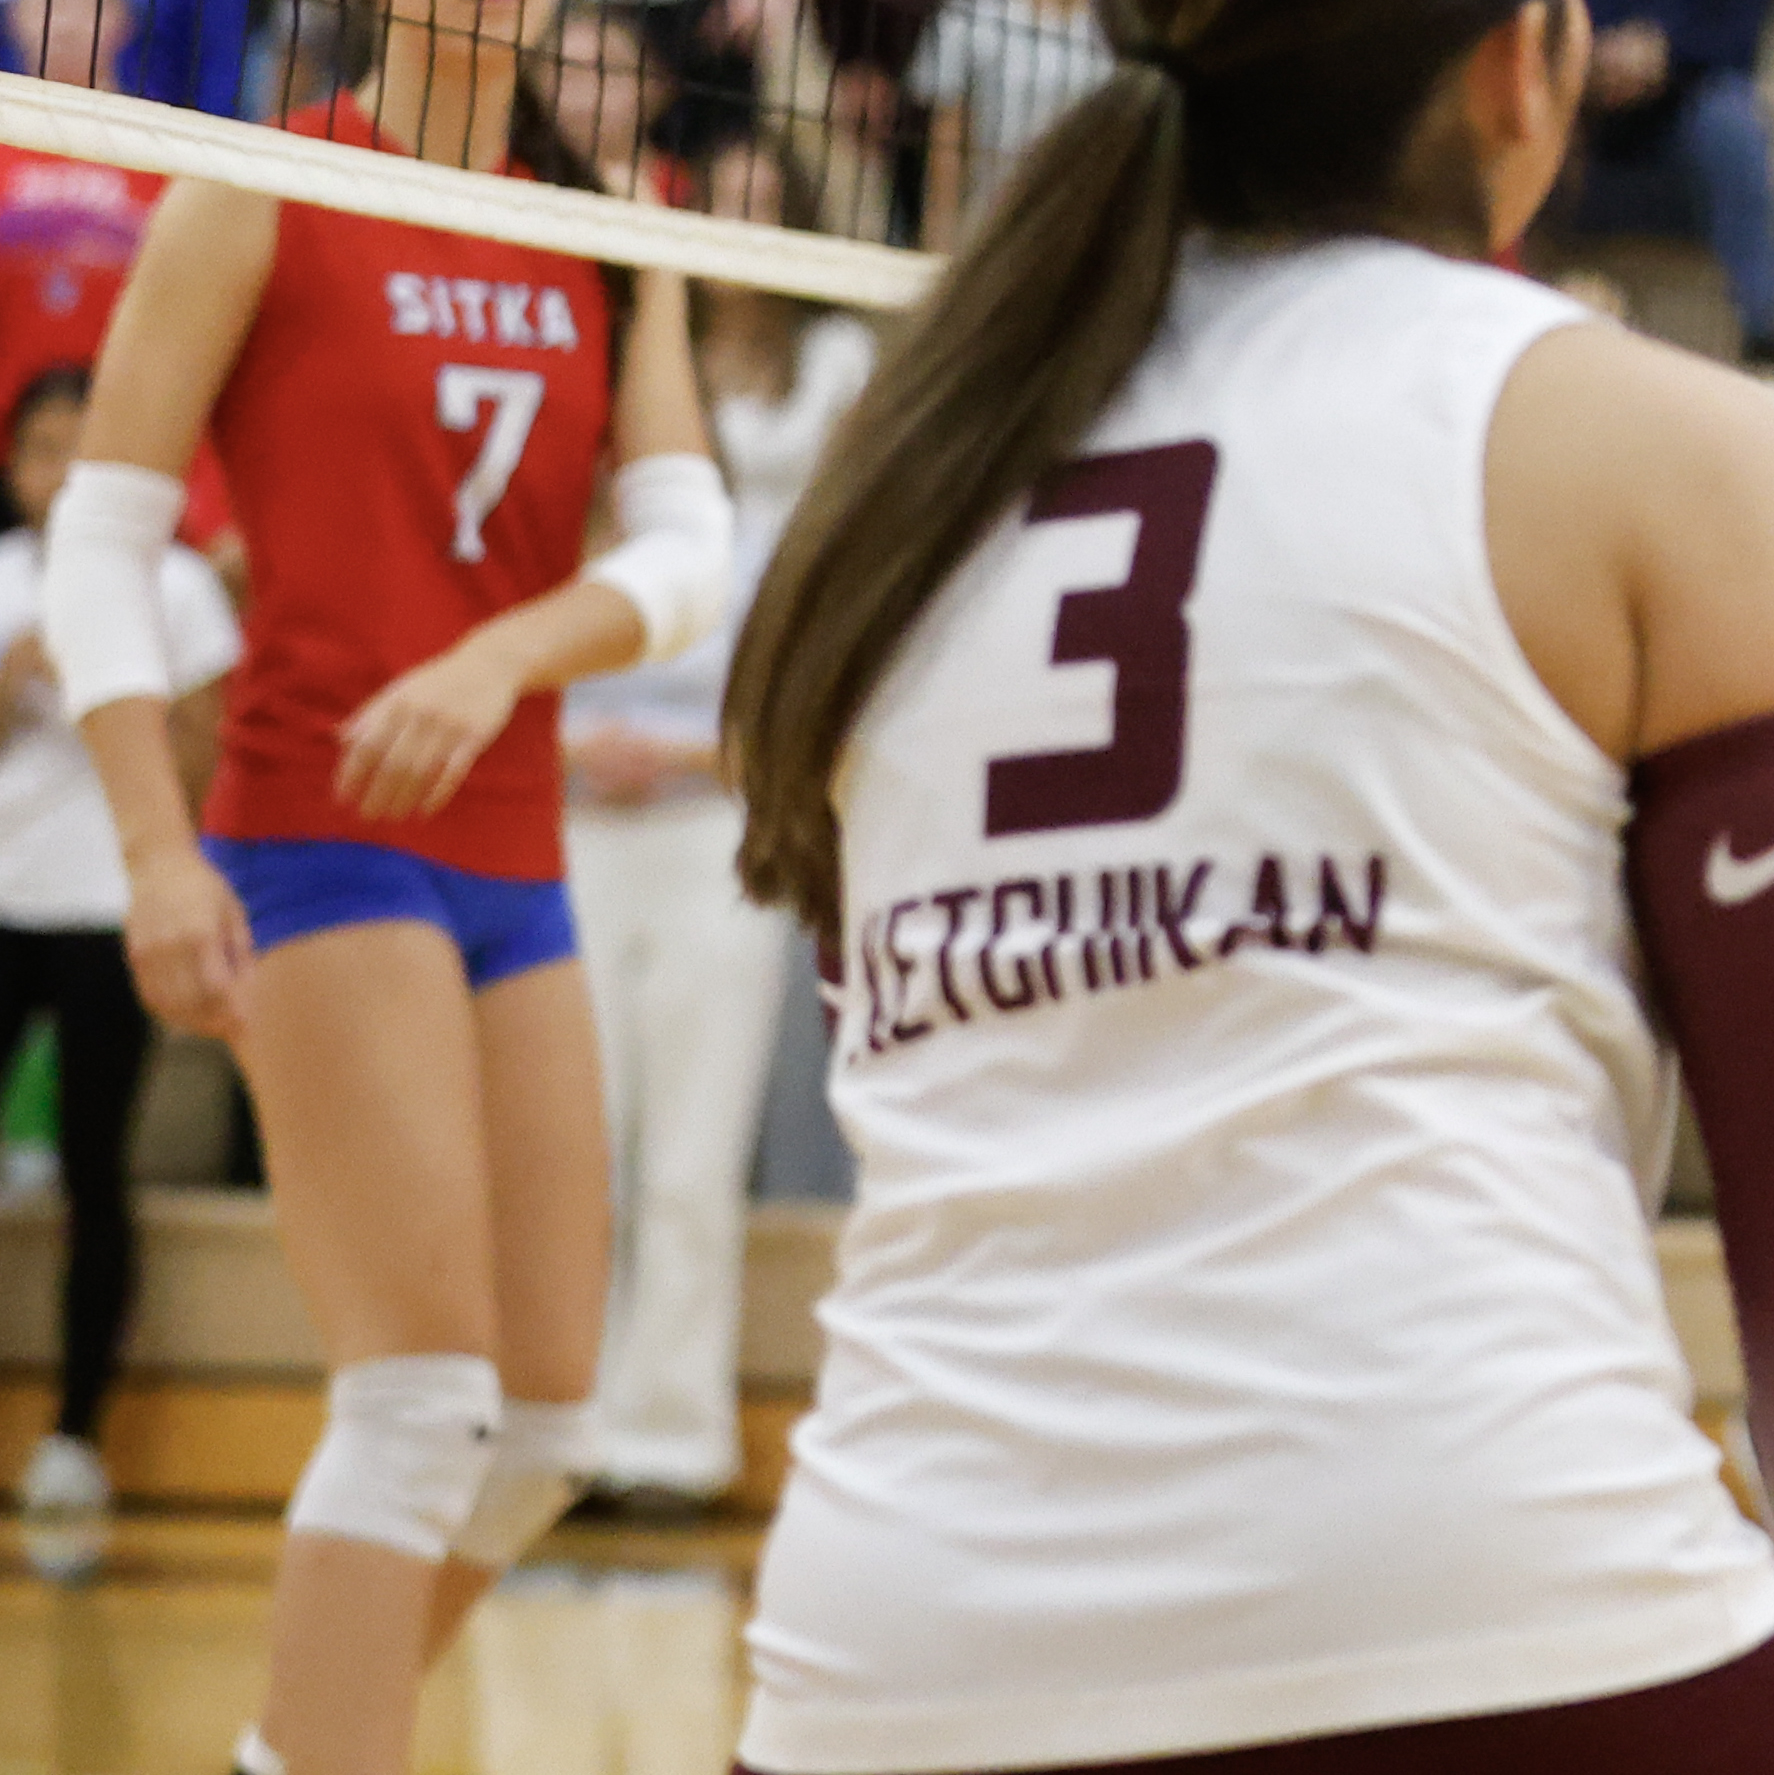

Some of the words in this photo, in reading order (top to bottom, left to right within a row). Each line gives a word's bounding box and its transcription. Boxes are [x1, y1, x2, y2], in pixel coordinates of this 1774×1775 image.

[385, 272, 578, 352] SITKA
[436, 362, 545, 564] 7
[984, 439, 1220, 840] 3
